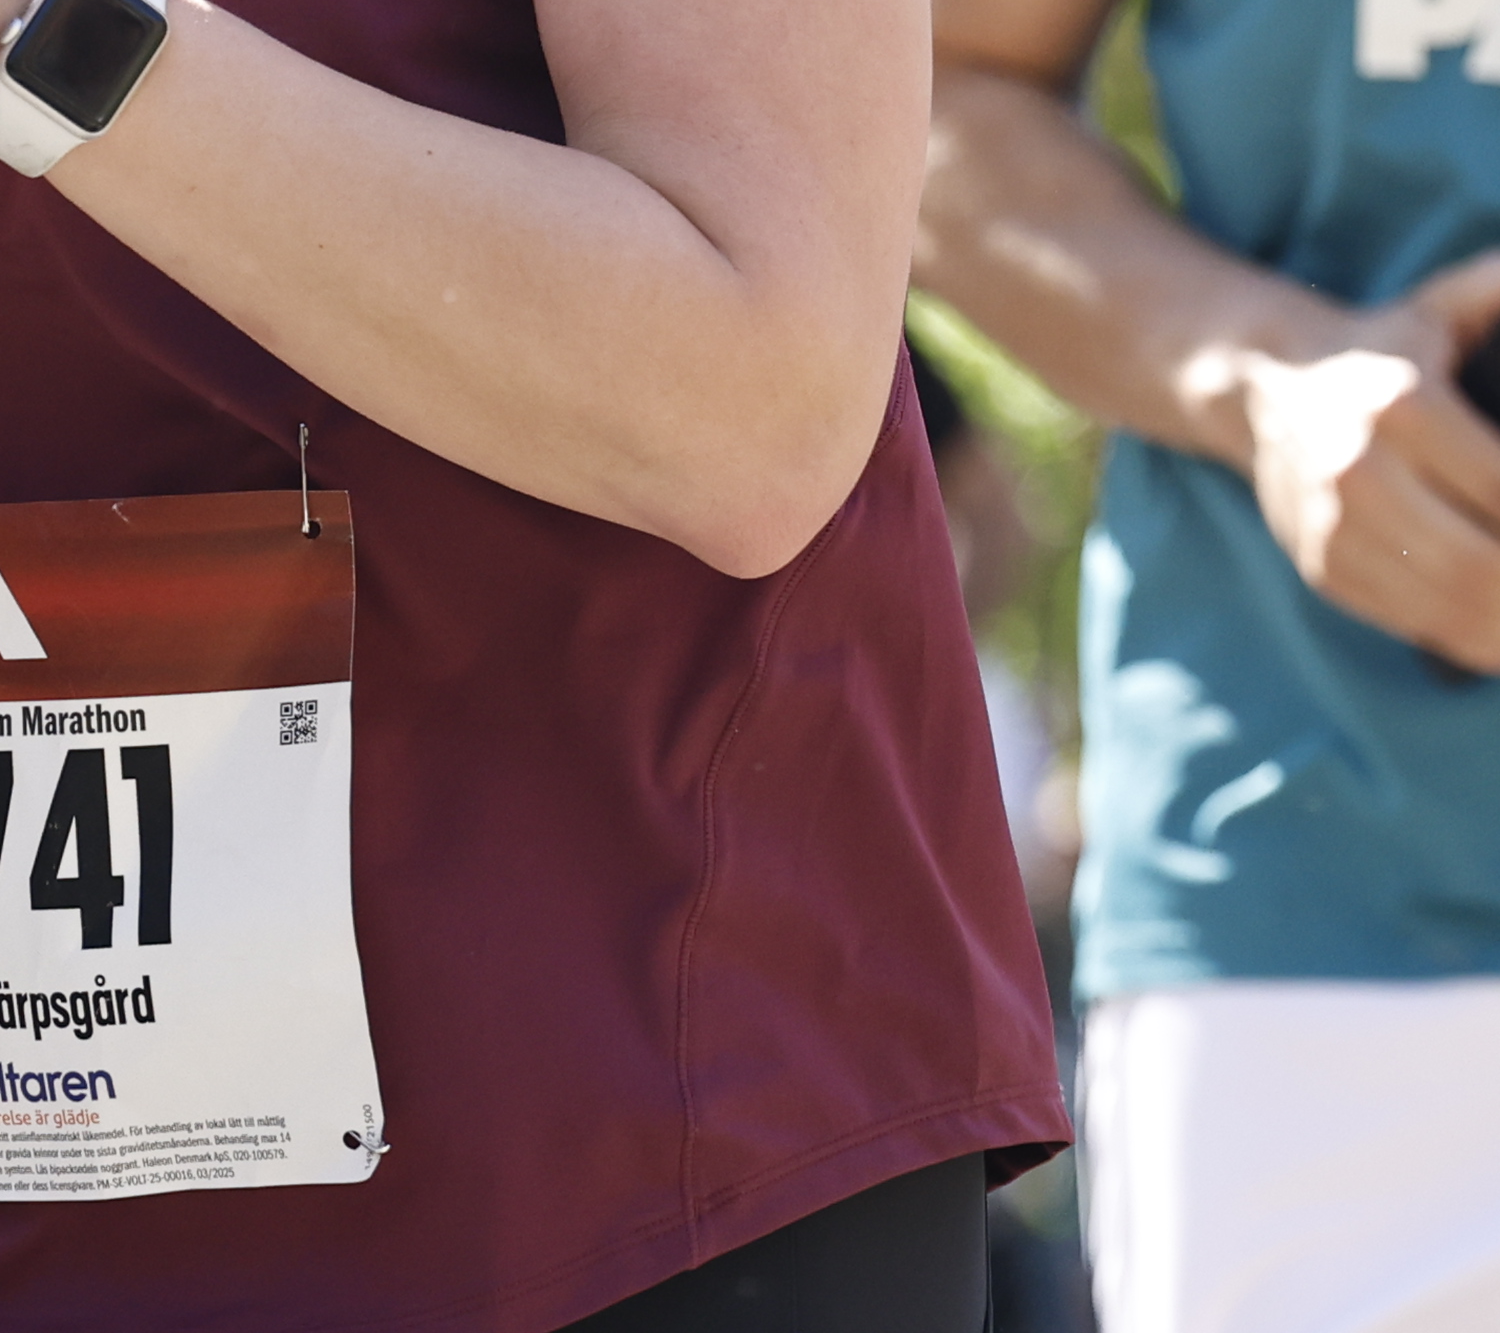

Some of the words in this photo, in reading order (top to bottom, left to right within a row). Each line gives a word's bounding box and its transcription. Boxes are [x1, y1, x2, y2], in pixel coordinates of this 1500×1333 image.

[22, 704, 146, 736] Marathon
[35, 1110, 49, 1125] är
[53, 1109, 100, 1128] glädje
